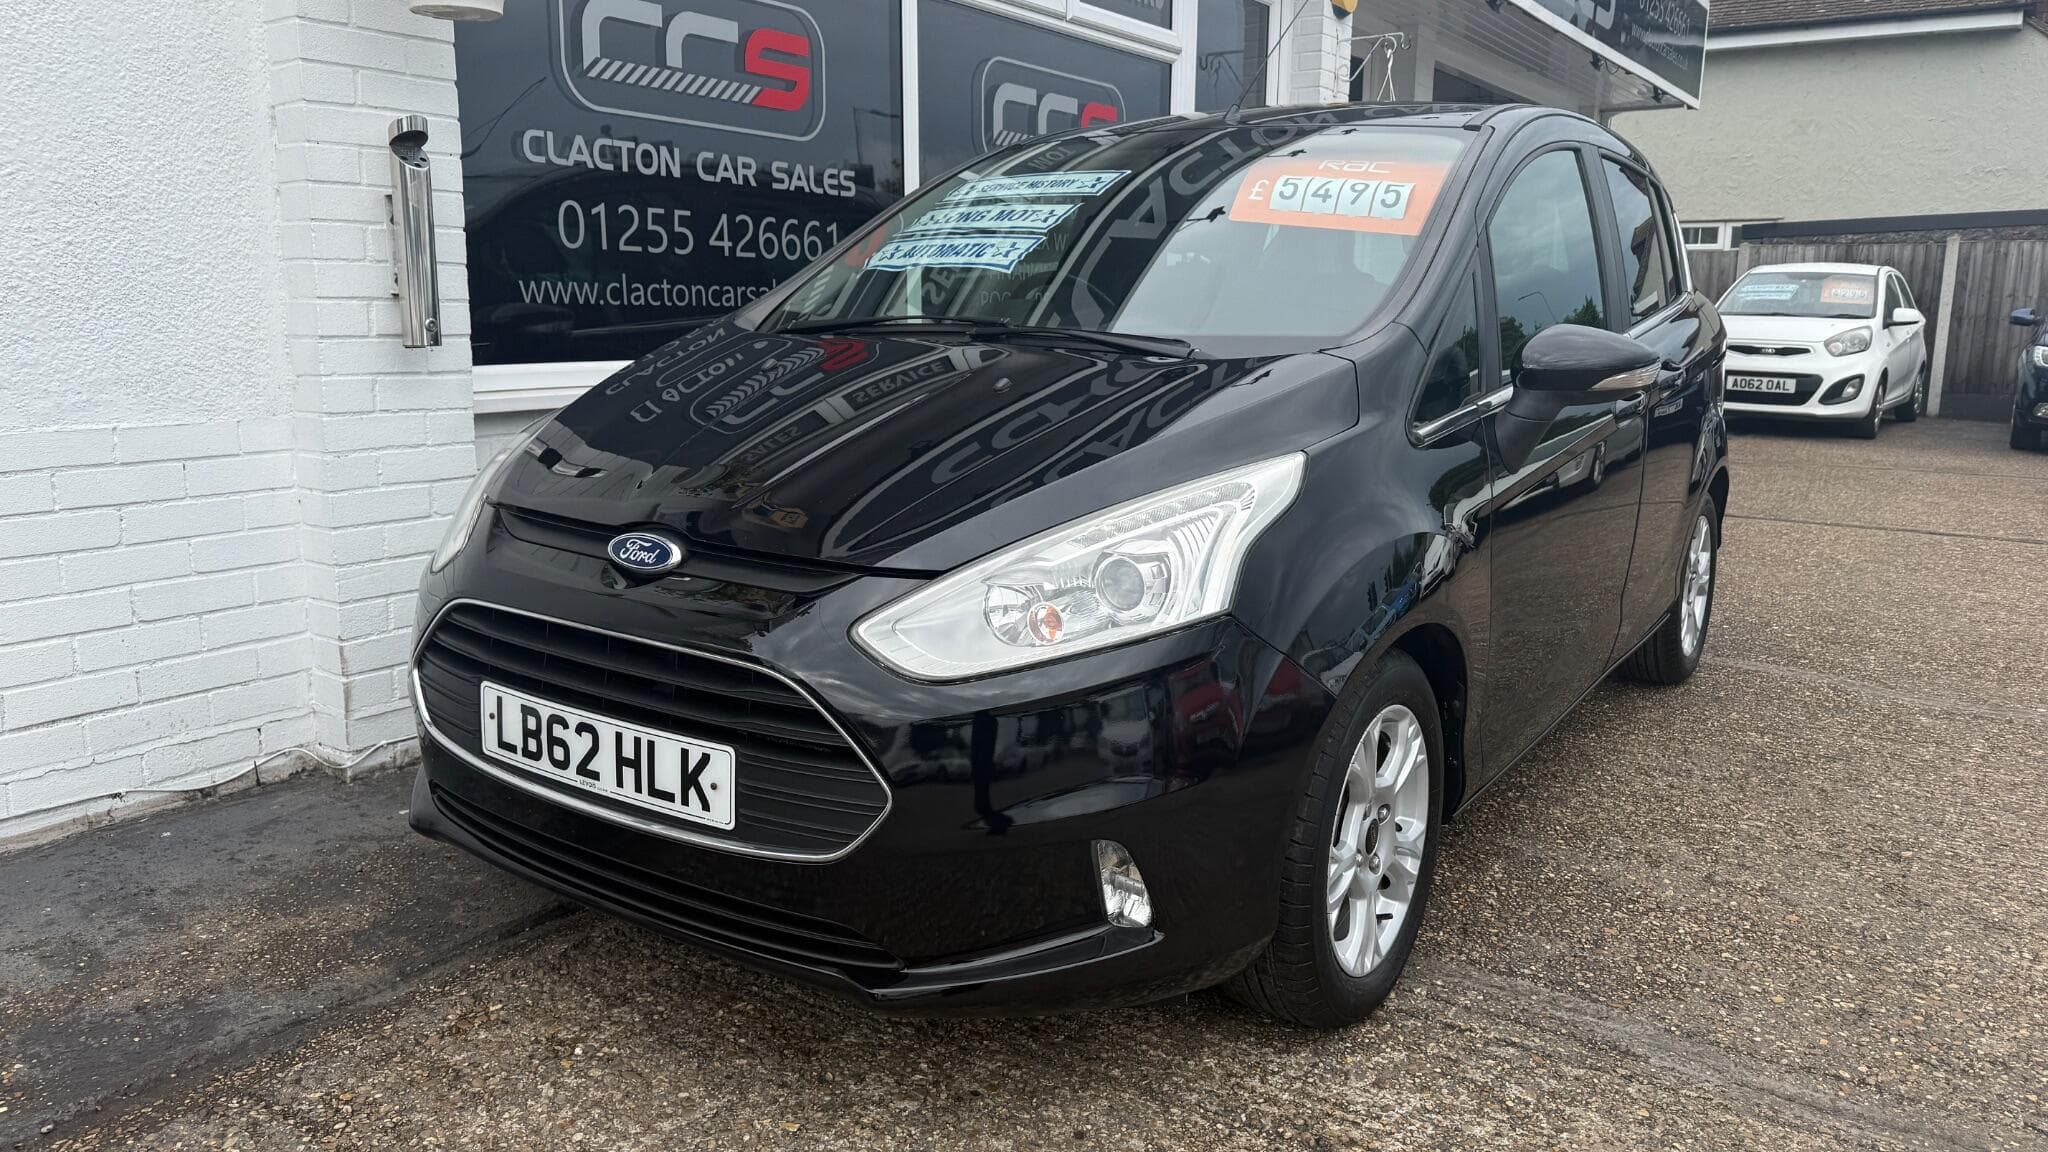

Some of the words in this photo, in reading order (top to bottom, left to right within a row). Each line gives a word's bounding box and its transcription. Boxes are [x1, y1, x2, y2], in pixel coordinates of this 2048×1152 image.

[521, 129, 681, 178] CLACTON
[696, 152, 757, 186] CAR
[771, 162, 856, 197] SALES
[1026, 178, 1077, 190] HISTORY
[1247, 179, 1270, 200] £
[1278, 177, 1405, 209] 5495
[557, 199, 694, 253] 01255
[709, 212, 839, 261] 426661
[935, 209, 988, 225] LONG
[989, 207, 1037, 223] MOT
[900, 241, 997, 260] AUTOMATIC
[620, 538, 661, 564] Ford
[496, 695, 601, 782] LB62
[615, 731, 711, 813] HLK
